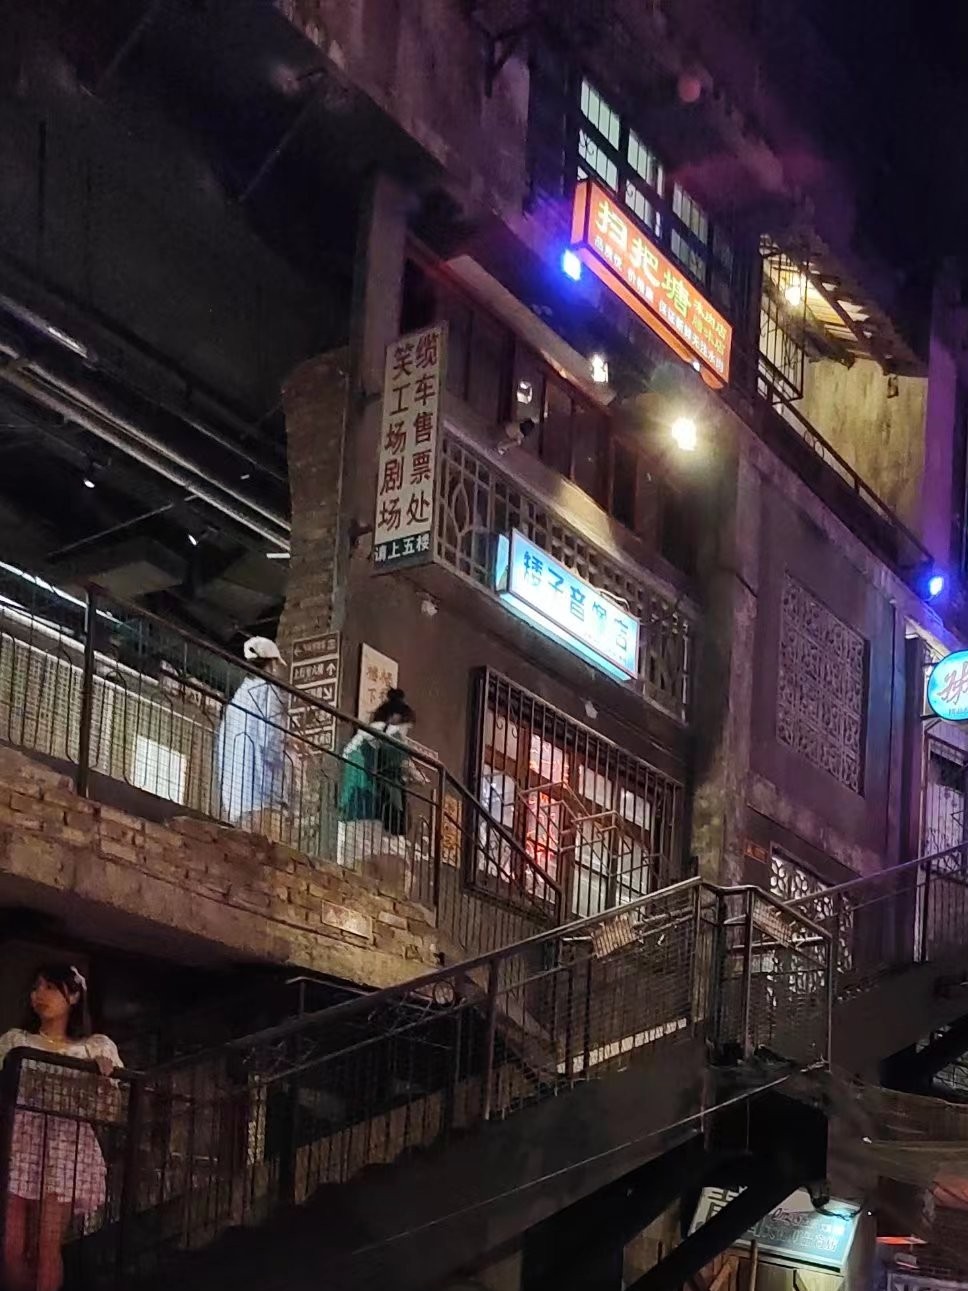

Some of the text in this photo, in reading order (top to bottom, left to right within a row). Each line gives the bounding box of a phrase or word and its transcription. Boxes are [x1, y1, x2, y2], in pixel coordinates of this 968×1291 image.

[595, 200, 692, 319] 扫把塘
[378, 343, 415, 532] 笑工场剧场
[406, 333, 439, 526] 缆车售票处
[374, 535, 431, 562] 请上五楼
